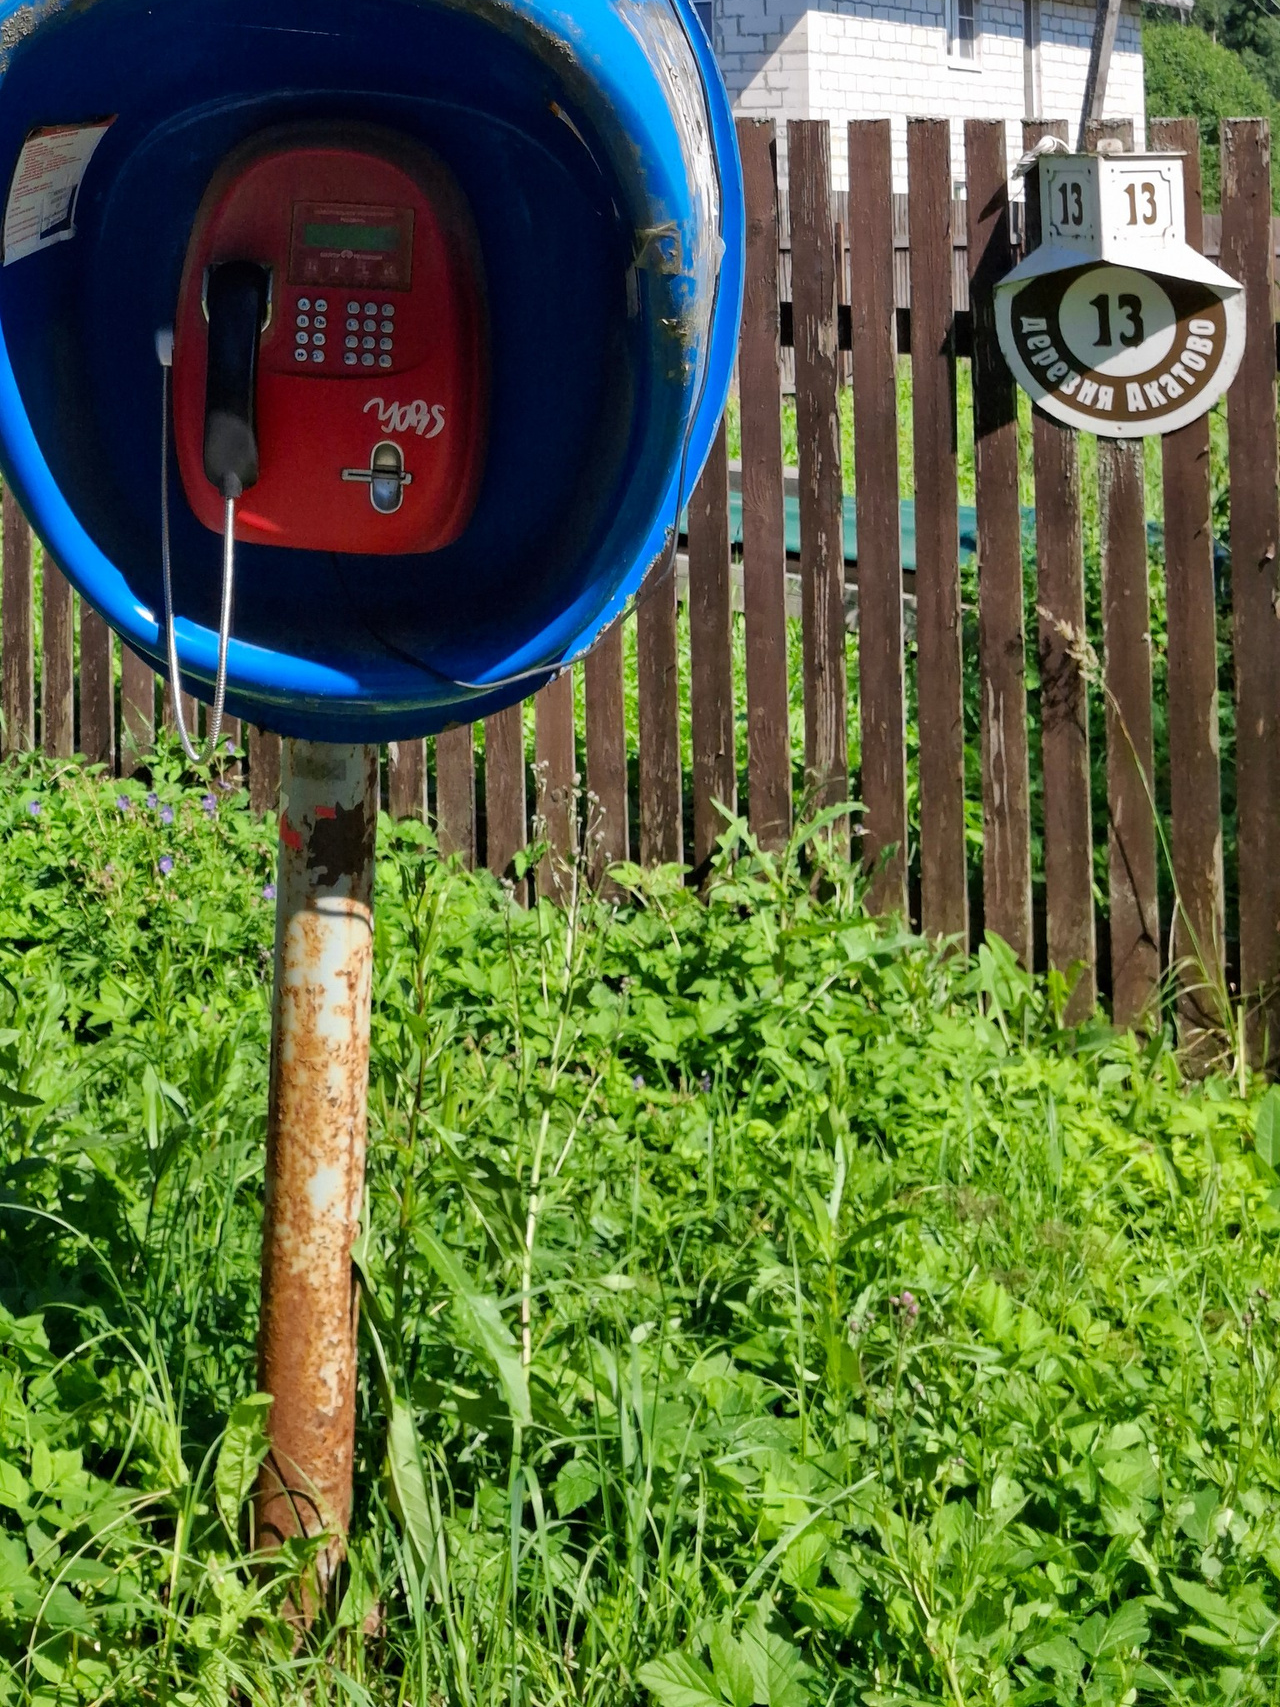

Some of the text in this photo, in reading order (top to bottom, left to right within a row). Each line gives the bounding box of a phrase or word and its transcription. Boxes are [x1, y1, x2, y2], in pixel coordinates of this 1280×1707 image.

[1058, 181, 1084, 226] 13
[1122, 181, 1158, 226] 13
[1089, 293, 1145, 348] 13
[1125, 318, 1216, 413] Акатово
